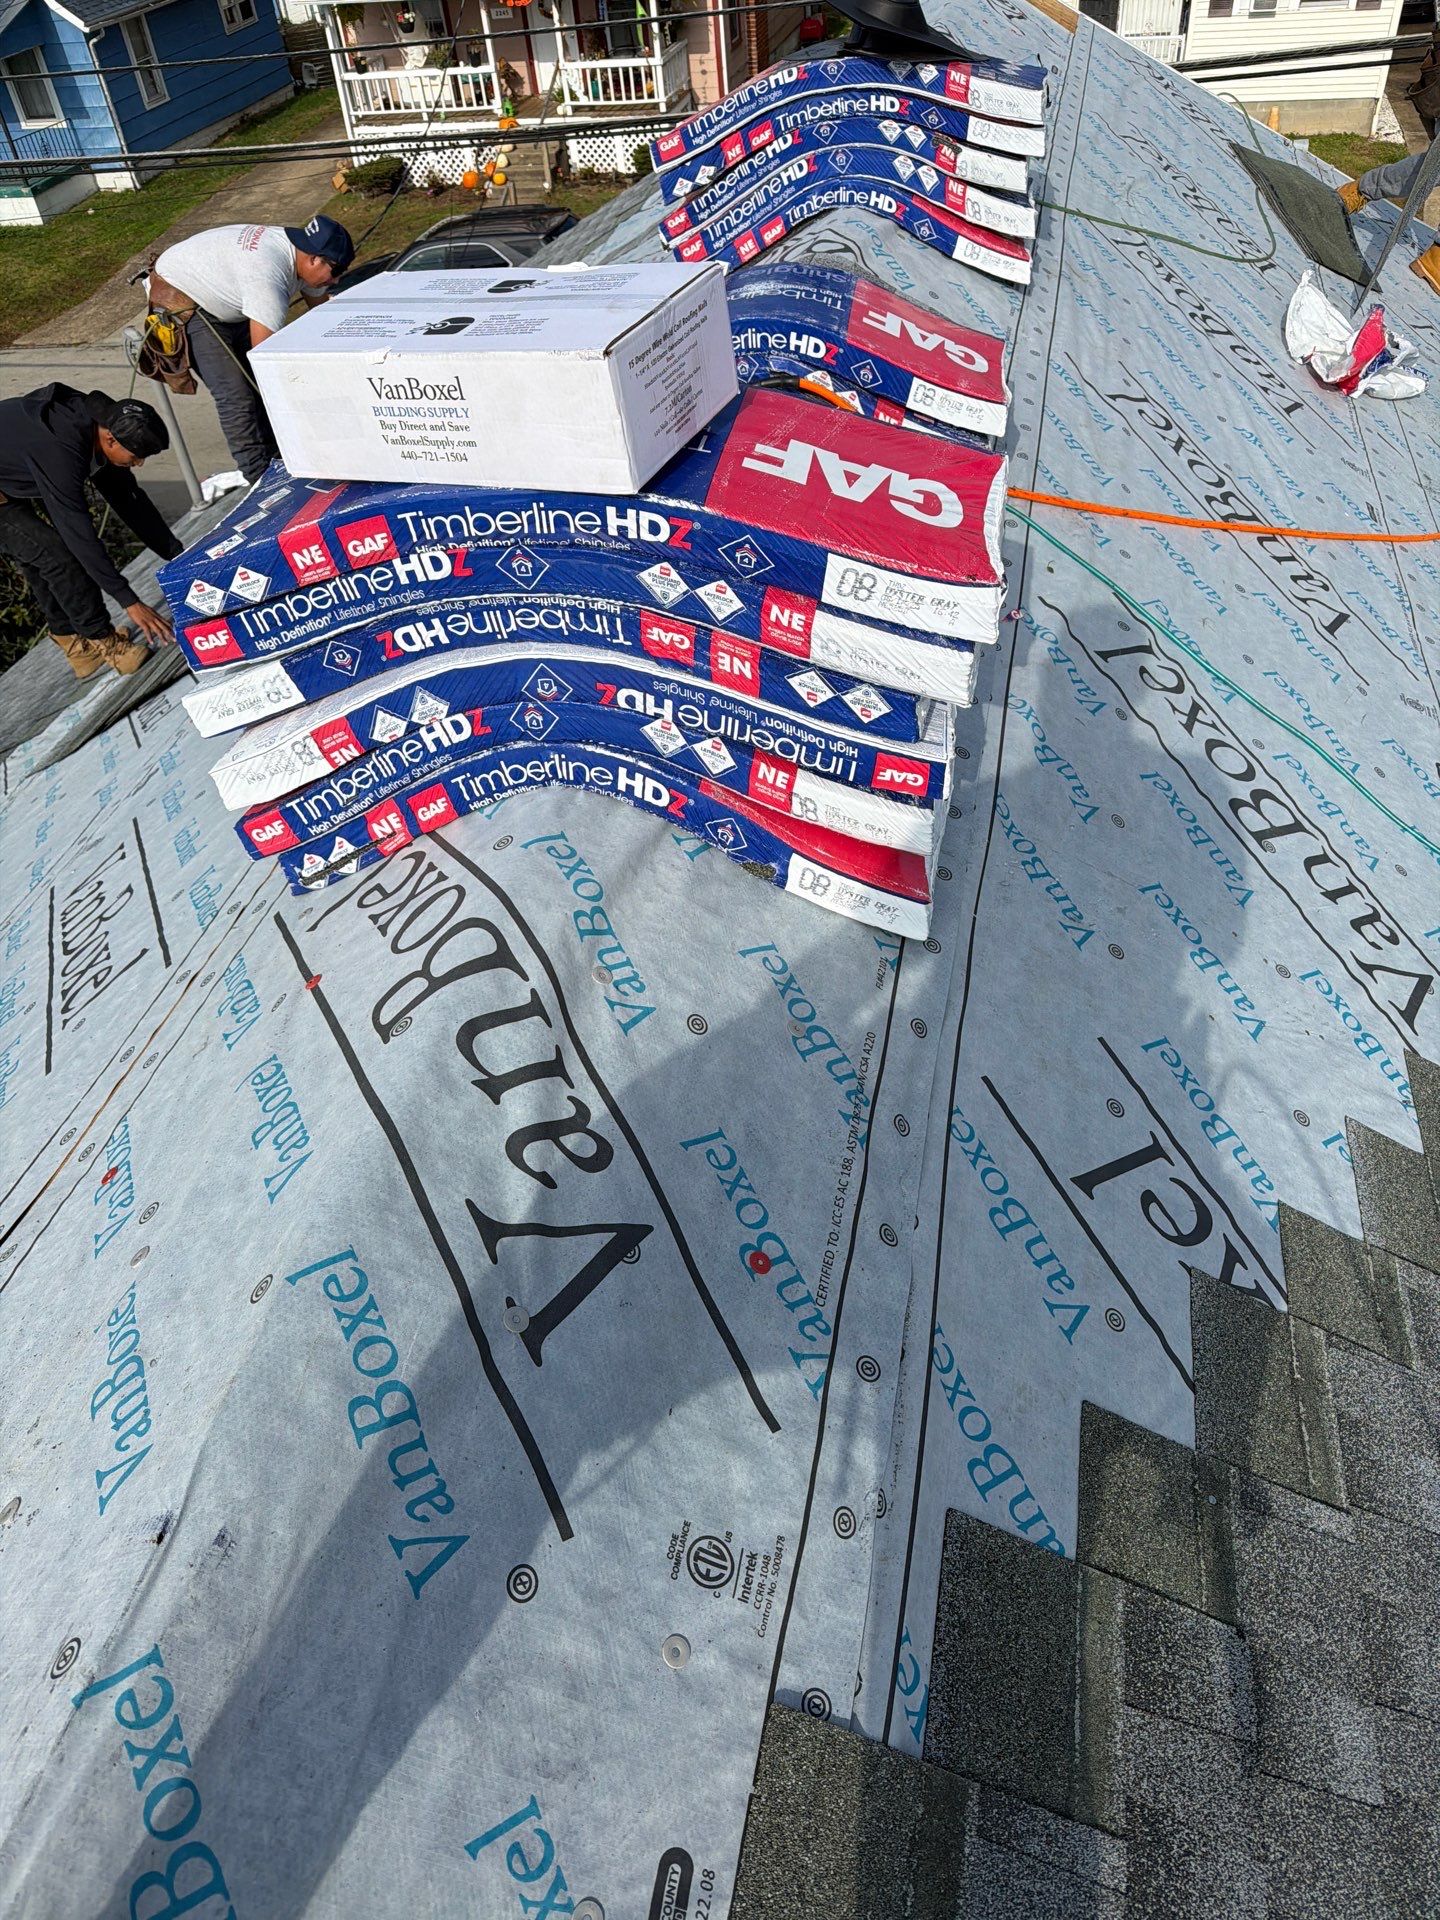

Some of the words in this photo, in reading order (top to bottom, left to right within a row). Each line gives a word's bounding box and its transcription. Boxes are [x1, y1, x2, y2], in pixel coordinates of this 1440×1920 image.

[949, 69, 969, 86] NE
[687, 79, 769, 138] Timberline
[692, 133, 707, 146] High
[758, 89, 783, 105] Shingles
[776, 97, 868, 131] Timberline
[870, 94, 909, 116] HDZ
[659, 135, 681, 153] GAF
[727, 145, 742, 163] NE
[752, 130, 771, 147] GAF
[692, 150, 767, 213] Timberline
[758, 158, 781, 179] Shingles
[703, 178, 782, 241] Timberline
[781, 154, 817, 187] HDZ
[773, 186, 796, 209] Shingles
[948, 180, 964, 196] NE
[667, 211, 687, 228] GAF
[785, 187, 868, 227] Timberline
[869, 190, 906, 221] HDZ
[682, 240, 702, 257] GAF
[739, 239, 755, 256] NE
[763, 224, 784, 243] GAF
[862, 310, 989, 373] GAF
[1110, 238, 1303, 418] VanBoxel
[732, 328, 787, 350] erline
[789, 332, 840, 365] HDZ
[366, 376, 466, 400] VanBoxel
[372, 406, 426, 418] BUILDING
[427, 408, 470, 419] SUPPLY
[379, 420, 397, 433] Buy
[399, 421, 427, 431] Direct
[429, 421, 446, 432] and
[448, 421, 470, 432] Save
[382, 435, 477, 449] VanBoxelSupply.com
[401, 451, 468, 462] 440-721-1504
[742, 438, 964, 528] GAF
[397, 502, 601, 542] Timberline
[606, 505, 693, 550] HDZ
[291, 544, 327, 569] NE
[347, 532, 389, 558] GAF
[836, 567, 878, 602] 08
[1138, 526, 1237, 617] VanBoxel
[236, 566, 394, 638] Timberline
[392, 549, 473, 585] HDZ
[416, 601, 465, 615] Shingles
[589, 598, 621, 614] High
[255, 636, 279, 651] High
[377, 590, 425, 610] Shingles
[447, 608, 632, 646] Timberline
[770, 604, 806, 632] NE
[193, 630, 229, 651] GAF
[375, 618, 450, 661] HDZ
[647, 626, 691, 650] GAF
[1252, 591, 1342, 686] VanBoxel
[718, 651, 752, 680] NE
[653, 680, 706, 706] Shingles
[1262, 670, 1361, 776] VanBoxel
[330, 743, 361, 767] NE
[677, 704, 858, 783] Timberline
[828, 739, 859, 758] High
[286, 739, 424, 825] Timberline
[420, 708, 491, 752] HDZ
[757, 761, 790, 789] NE
[878, 768, 924, 787] GAF
[308, 819, 331, 836] High
[411, 753, 452, 778] Shingles
[451, 753, 613, 801] Timberline
[617, 767, 686, 819] HDZ
[417, 797, 449, 822] GAF
[469, 797, 495, 811] High
[1272, 751, 1380, 873] VanBoxel
[251, 821, 285, 842] GAF
[372, 812, 402, 839] NE
[1095, 638, 1435, 1036] VanBoxel
[1139, 770, 1256, 910] VanBoxel
[520, 831, 657, 1036] VanBoxel
[1138, 881, 1268, 1044] VanBoxel
[738, 942, 872, 1149] VanBoxel
[863, 1031, 877, 1056] A220
[856, 1056, 872, 1094] CAN/CSA
[307, 843, 654, 1367] VanBoxel
[235, 1053, 314, 1205] VanBoxel
[846, 1125, 860, 1153] ASTM
[841, 1157, 856, 1178] 188,
[837, 1178, 849, 1195] AC
[831, 1196, 845, 1228] ICC-ES
[827, 1229, 841, 1251] TO:
[680, 1127, 832, 1401] VanBoxel
[815, 1250, 836, 1308] CERTIFIED
[285, 1244, 471, 1601] VanBoxel
[666, 1532, 680, 1560] CODE
[670, 1520, 691, 1581] COMPLIANCE
[724, 1530, 733, 1543] US
[770, 1535, 786, 1578] 5008478
[738, 1551, 758, 1604] Intertek
[753, 1554, 772, 1610] CCRR-1048
[767, 1580, 778, 1598] No.
[757, 1600, 773, 1638] Control
[72, 1643, 235, 1920] Boxel
